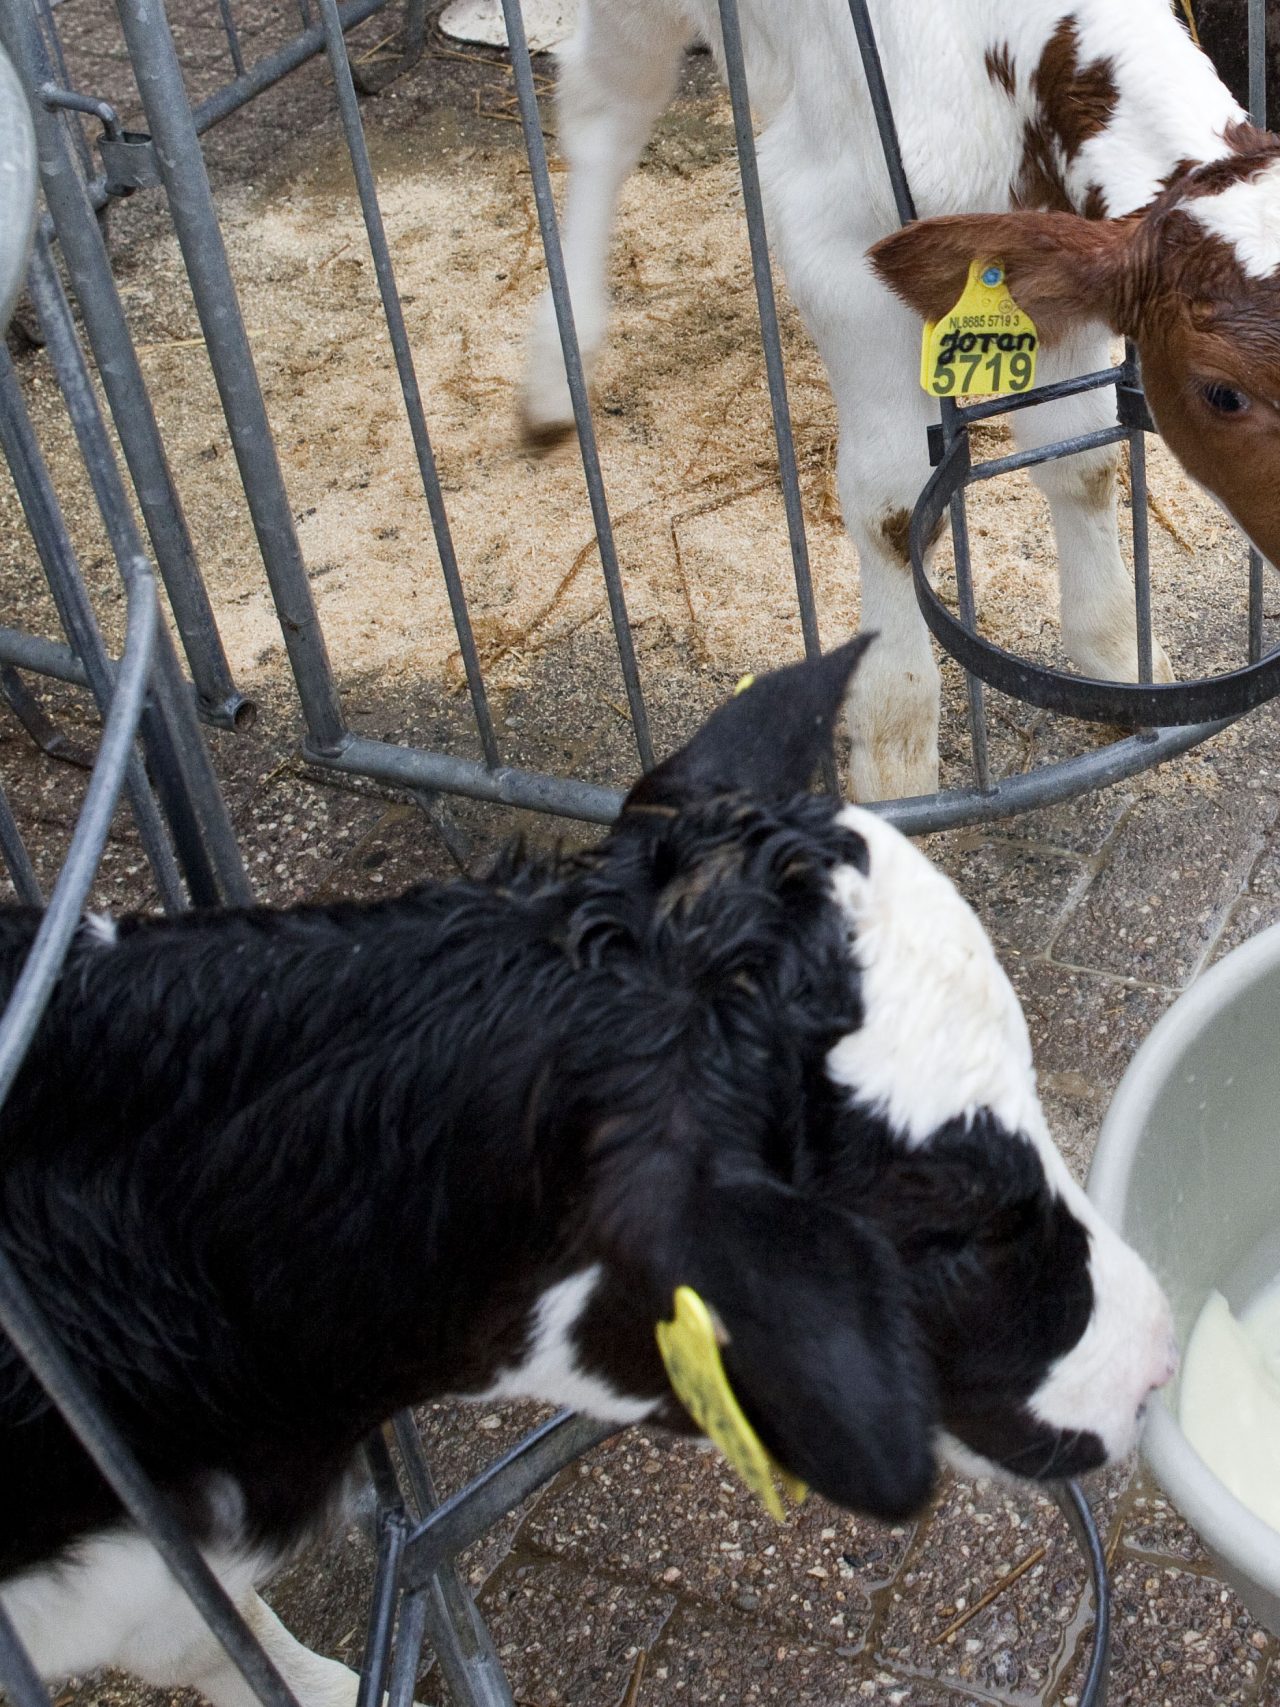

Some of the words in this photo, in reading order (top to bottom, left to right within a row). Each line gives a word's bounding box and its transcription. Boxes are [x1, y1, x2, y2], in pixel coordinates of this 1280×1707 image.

[987, 314, 1011, 327] 5719
[1013, 314, 1020, 327] 3
[932, 352, 1032, 395] 5719
